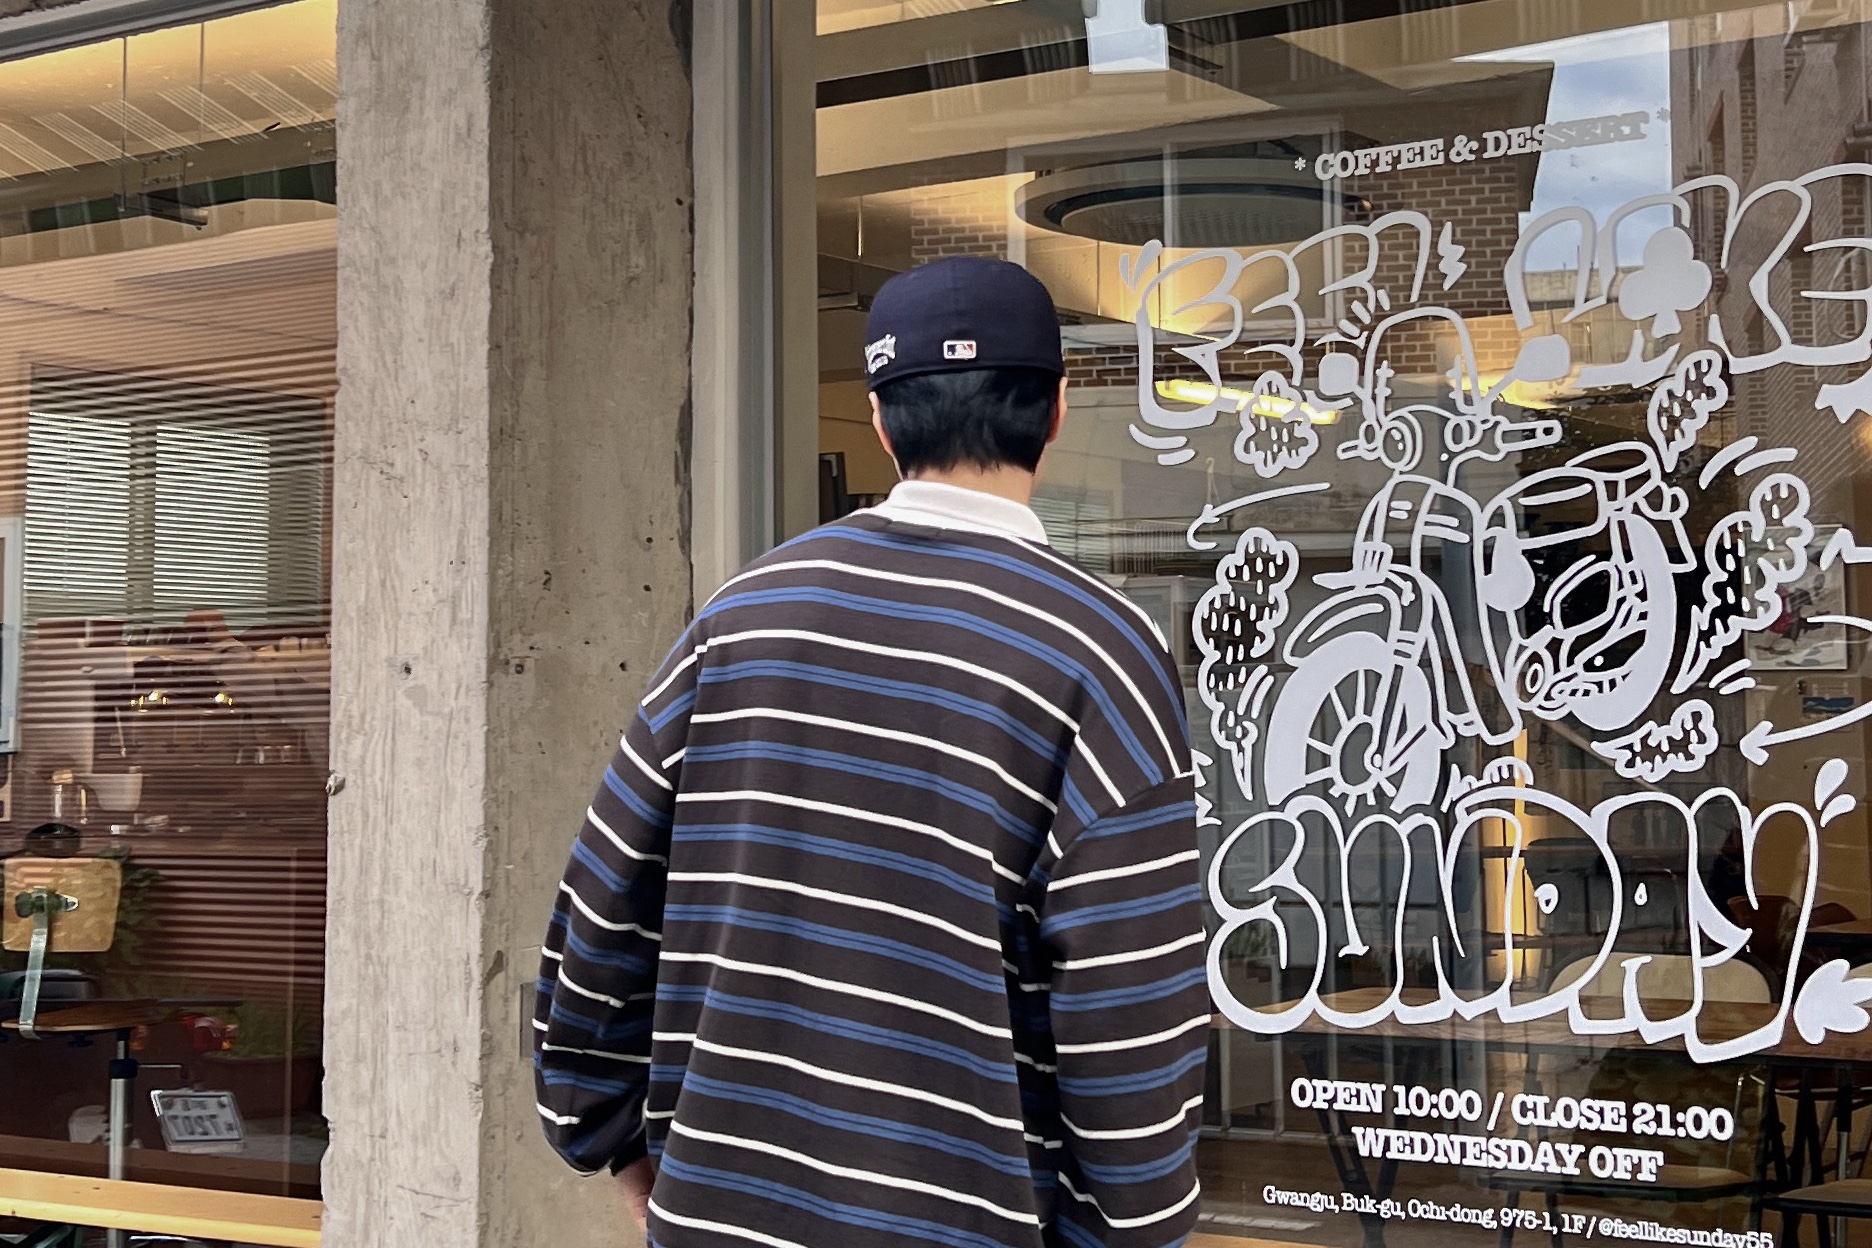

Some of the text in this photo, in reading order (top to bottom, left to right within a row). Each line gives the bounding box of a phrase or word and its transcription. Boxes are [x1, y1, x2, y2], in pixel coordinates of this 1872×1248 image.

[1314, 111, 1650, 181] COFFEE & DESSERT
[1290, 1077, 1735, 1141] OPEN 10:00 / CLOSE 21:00
[1351, 1126, 1664, 1183] WEDNESDAY OFF
[1262, 1185, 1340, 1214] Gwangju,
[1341, 1192, 1406, 1220] Buk-gu,
[1407, 1199, 1498, 1229] Ochi-dong,
[1500, 1207, 1559, 1235] 975-1,
[1561, 1212, 1587, 1235] 1F
[1586, 1215, 1597, 1239] /
